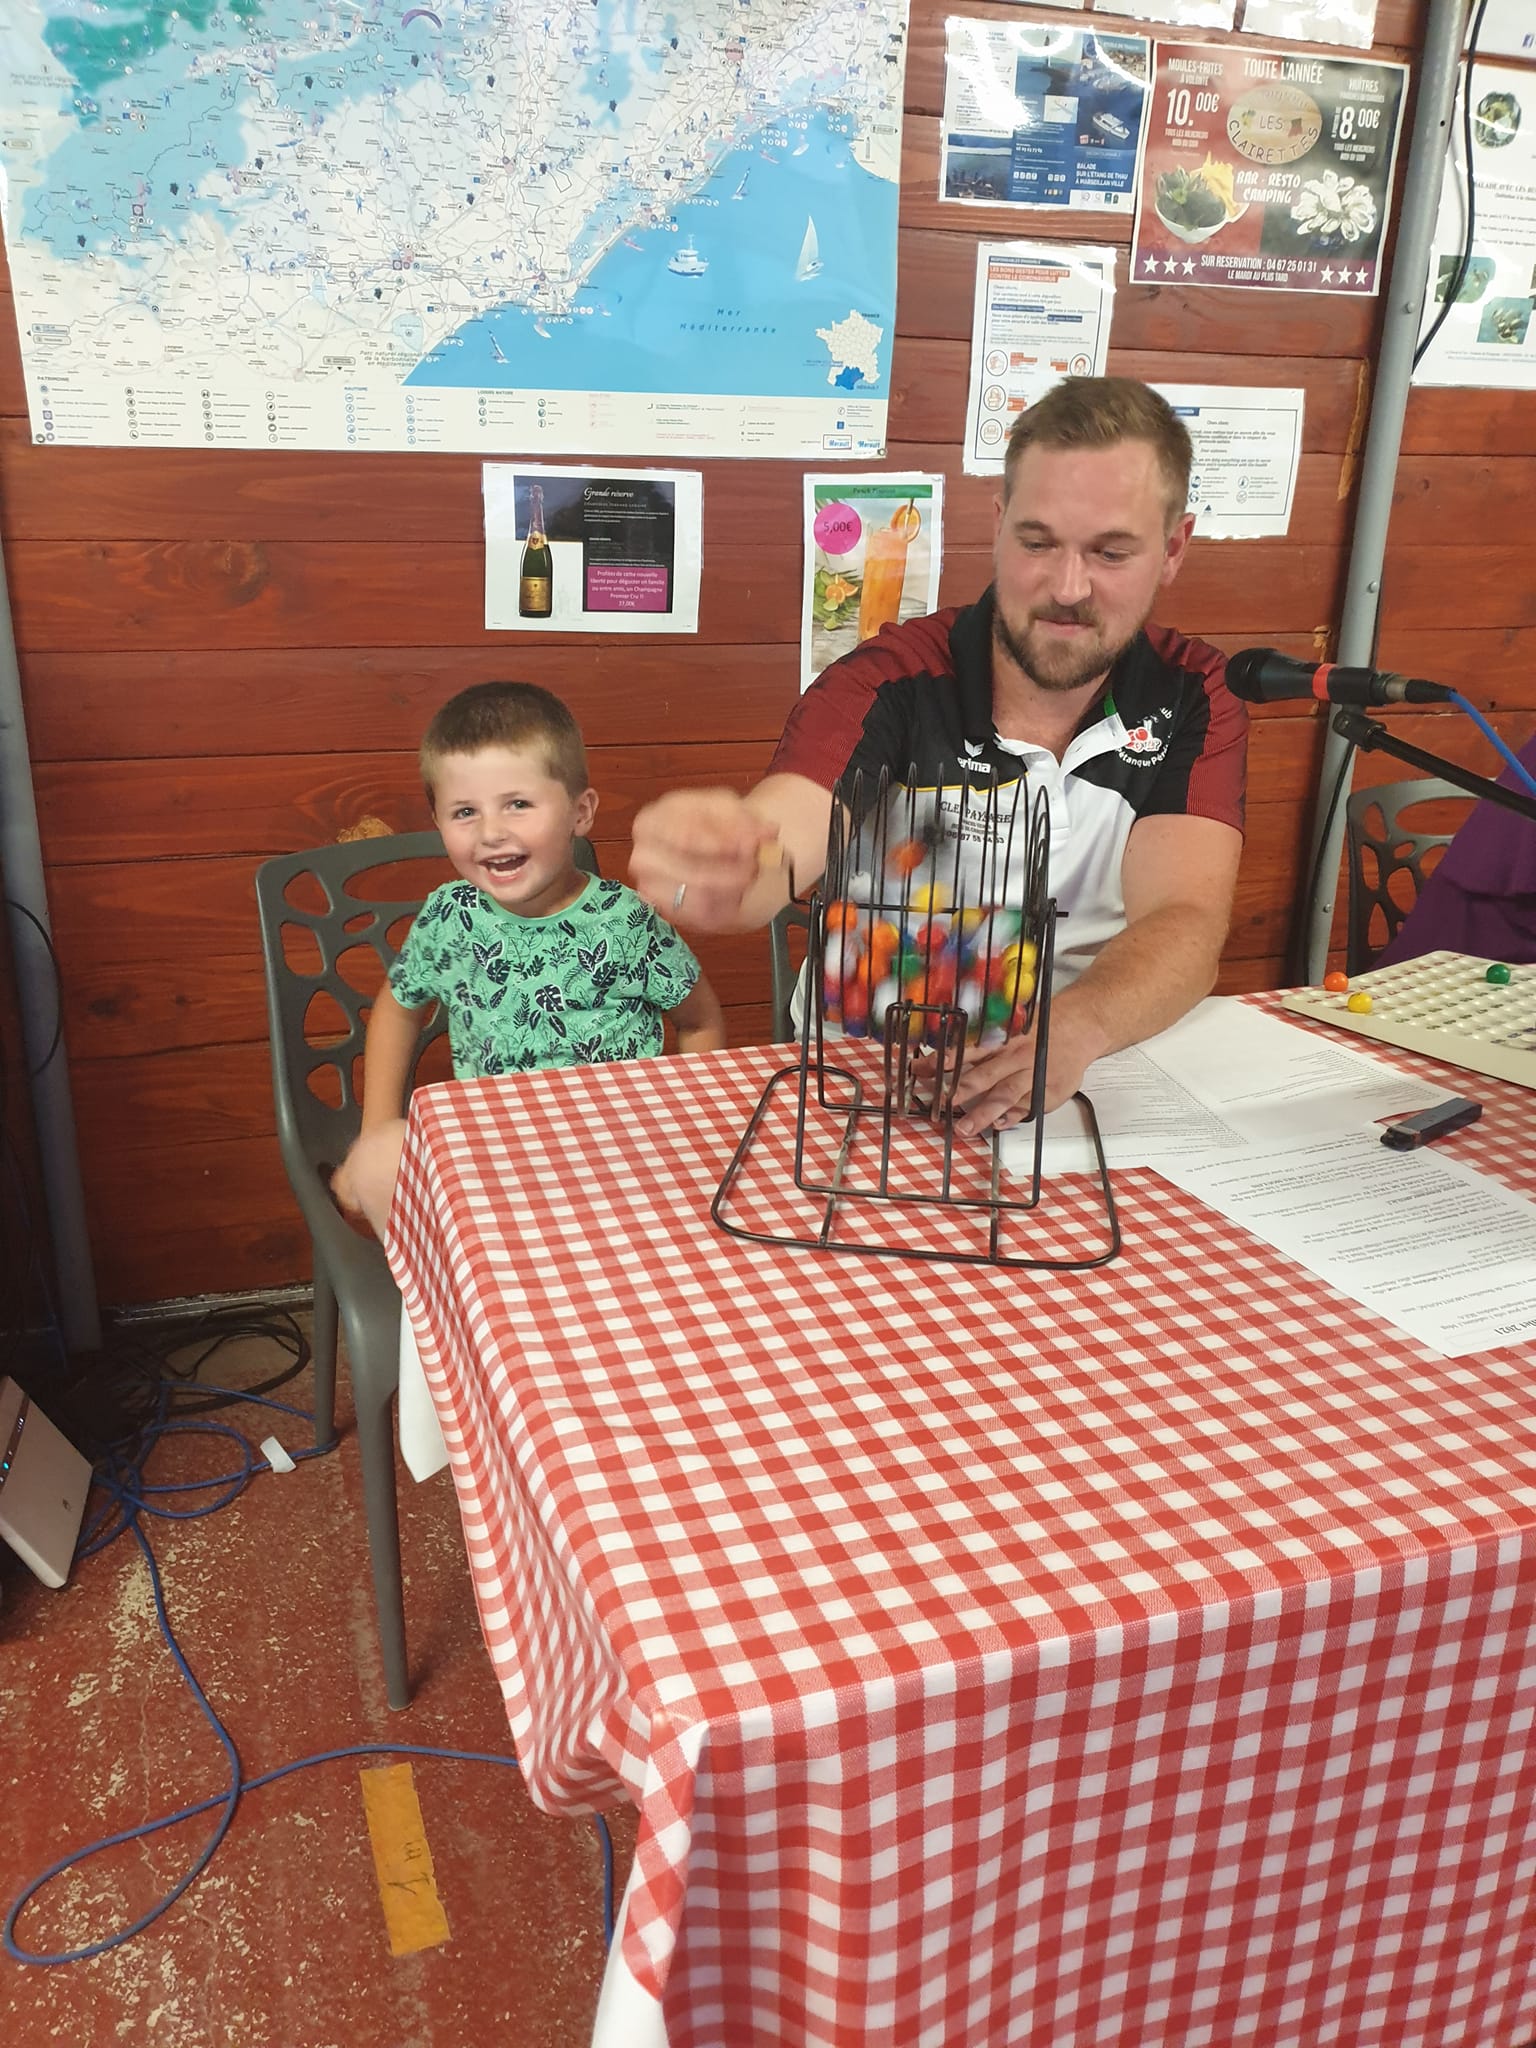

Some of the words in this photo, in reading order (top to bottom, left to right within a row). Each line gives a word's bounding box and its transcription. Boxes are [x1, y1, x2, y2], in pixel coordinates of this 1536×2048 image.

[1168, 58, 1223, 75] MOULES-FRITES
[1244, 58, 1278, 79] TOUTE
[1281, 62, 1324, 84] L'ANNÉE
[1260, 116, 1283, 130] LES
[1229, 120, 1318, 162] CLAIRETTES
[1237, 171, 1259, 185] BAR
[1268, 173, 1300, 187] RESTO
[1243, 188, 1292, 204] CAMPING
[1201, 255, 1215, 267] SUR
[1216, 256, 1262, 270] RESERVATION
[1266, 259, 1276, 270] 04
[1297, 261, 1307, 272] 01
[1307, 261, 1317, 272] 31
[717, 308, 741, 316] Mer
[823, 521, 853, 534] 5,00€
[957, 757, 991, 773] erima
